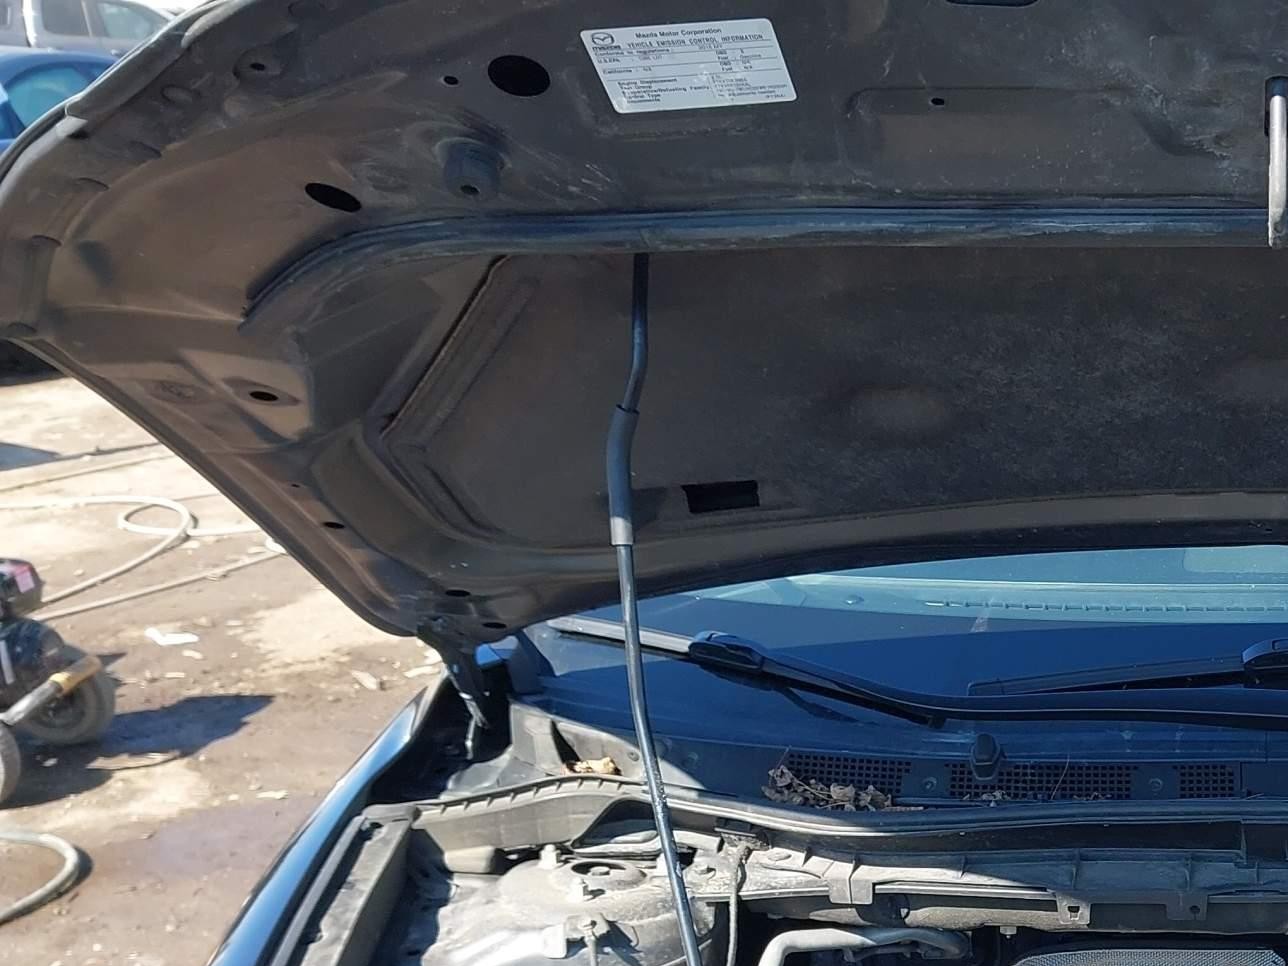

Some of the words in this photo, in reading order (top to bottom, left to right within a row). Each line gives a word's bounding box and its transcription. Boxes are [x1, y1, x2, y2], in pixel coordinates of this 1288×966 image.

[627, 41, 653, 49] VEHICLE
[656, 39, 686, 47] EMISSION
[721, 34, 763, 42] INFORMATION
